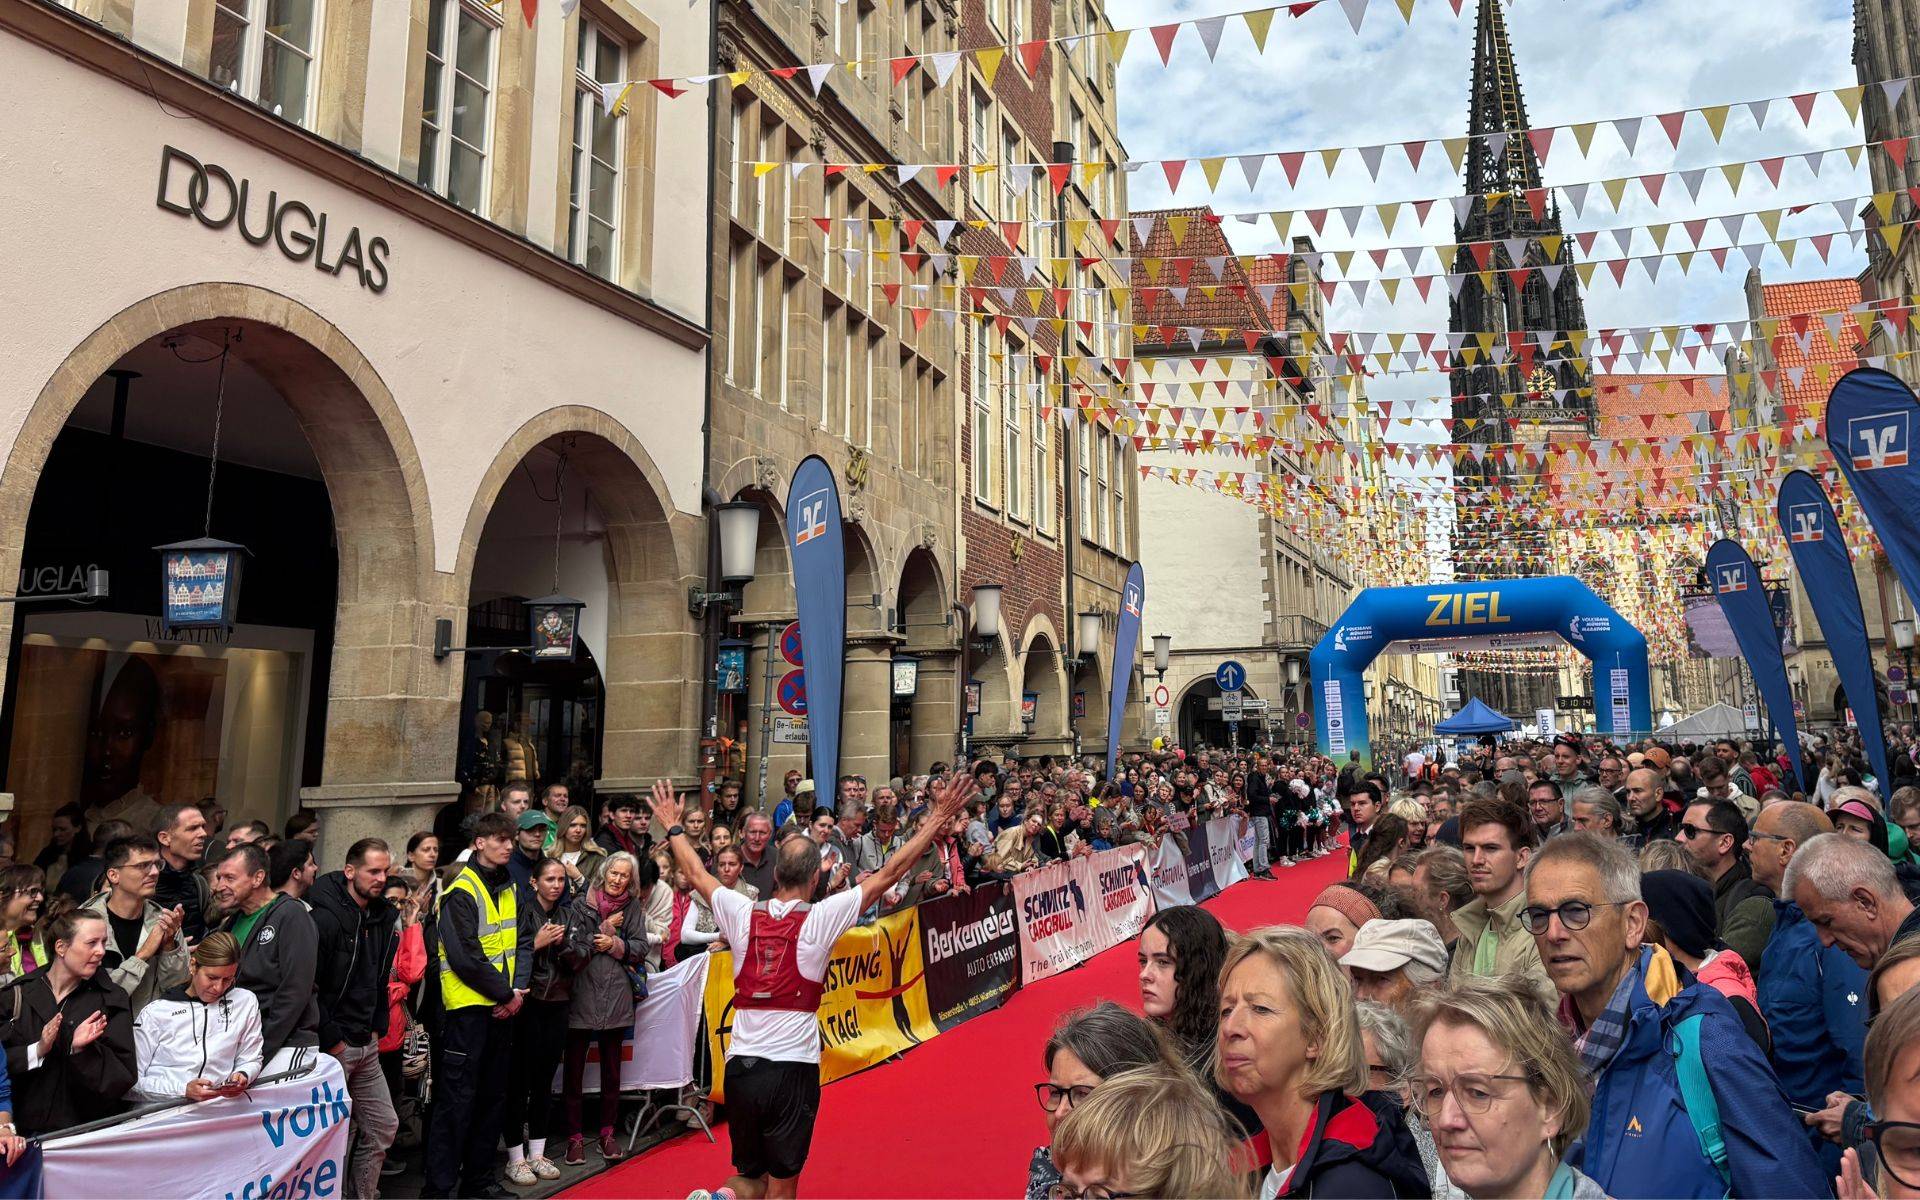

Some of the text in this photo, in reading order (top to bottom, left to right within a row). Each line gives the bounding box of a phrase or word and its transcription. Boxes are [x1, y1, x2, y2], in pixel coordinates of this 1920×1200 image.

[157, 145, 389, 293] DOUGLAS
[1425, 592, 1511, 626] ZIEL
[1099, 864, 1134, 895] SCHMITZ
[927, 905, 1015, 964] Berkemeier
[966, 957, 986, 978] AUTO
[1030, 960, 1048, 974] The
[827, 1005, 862, 1045] TAG!
